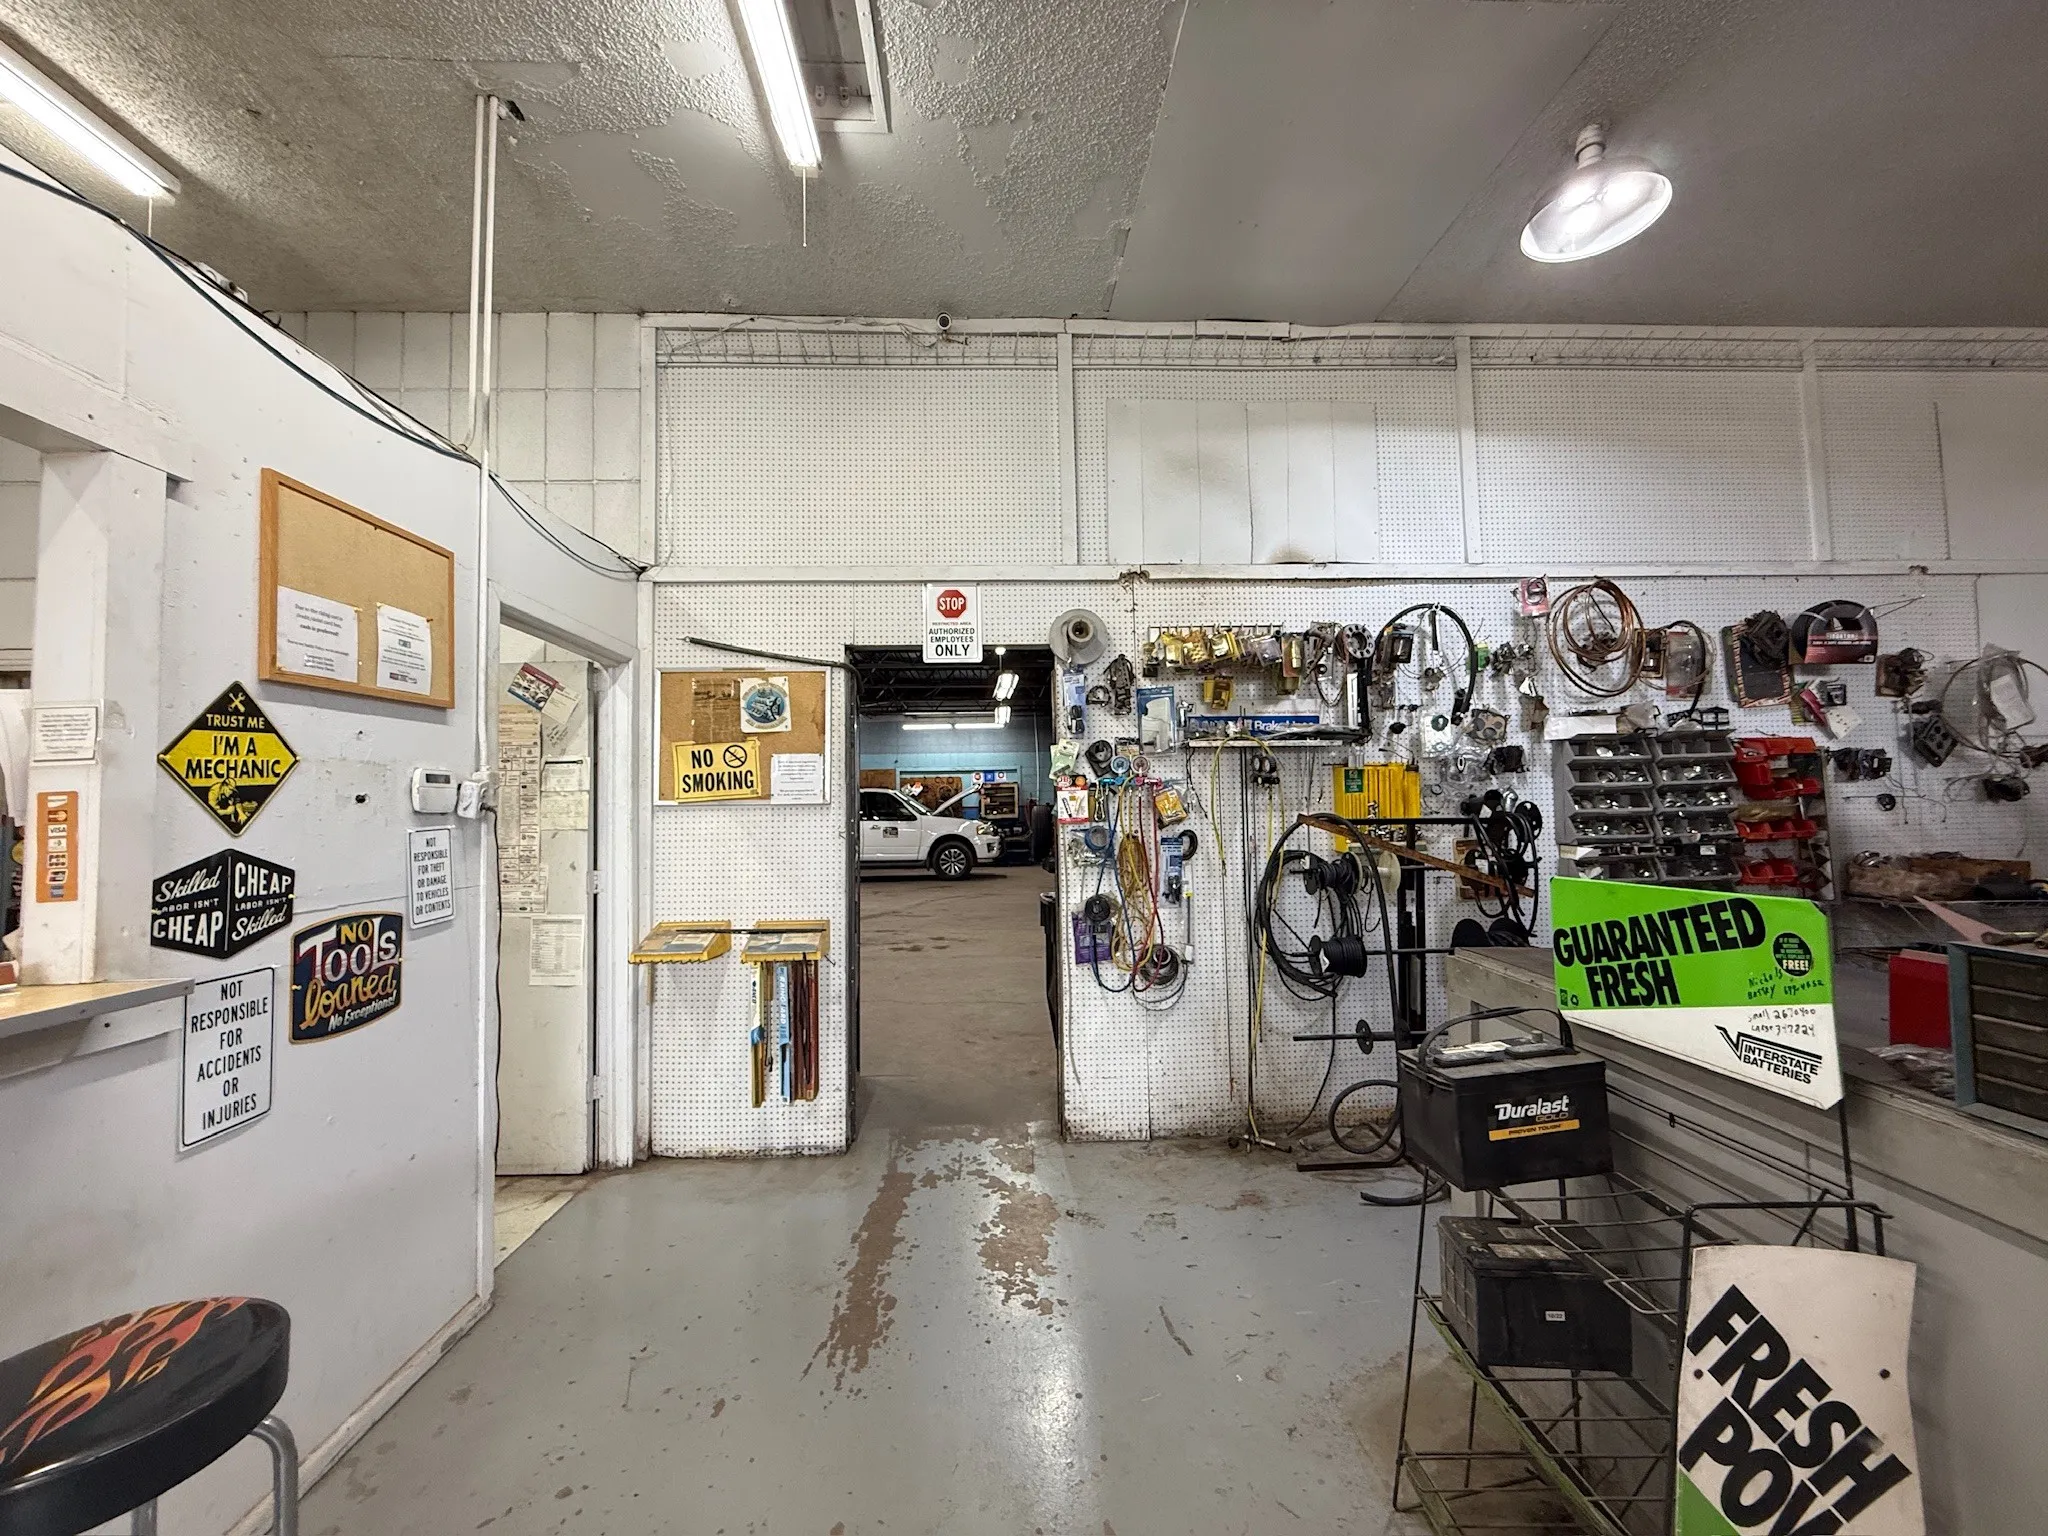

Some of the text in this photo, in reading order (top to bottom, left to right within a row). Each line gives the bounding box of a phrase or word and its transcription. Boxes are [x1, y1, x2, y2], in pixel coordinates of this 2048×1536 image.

[939, 597, 964, 610] STOP
[936, 644, 970, 656] ONLY
[206, 714, 265, 729] TRUST ME
[213, 736, 257, 756] I'M A
[185, 758, 281, 779] MECHANIC
[691, 748, 714, 768] NO
[682, 770, 754, 793] SMOKING
[426, 837, 436, 848] NOT
[414, 849, 448, 862] RESPONSIBLE
[418, 862, 444, 875] FOR THEFT
[155, 865, 222, 902] Skilled
[234, 862, 292, 898] CHEAP
[417, 875, 446, 888] OR DAMAGE
[235, 897, 287, 912] LABOR ISN'T
[416, 888, 448, 902] TO VEHICLES
[157, 898, 220, 914] ABOR ISN'T
[416, 900, 450, 916] OR CONTENTS
[153, 911, 224, 948] CHEAP
[232, 904, 288, 941] Skilled
[340, 920, 374, 944] NO
[1554, 897, 1766, 968] GUARANTEED
[1782, 960, 1809, 971] FREE!
[220, 980, 243, 1000] NOT
[1585, 958, 1681, 1008] FRESH
[299, 966, 397, 1030] loaned
[191, 996, 268, 1034] RESPONSIBLE
[328, 990, 397, 1031] No Exceptions!
[220, 1028, 242, 1050] FOR
[196, 1045, 262, 1082] ACCIDENTS
[1743, 1054, 1812, 1084] BATTERIES
[1745, 1044, 1819, 1076] INTERSTATE
[222, 1077, 238, 1096] OR
[202, 1093, 257, 1130] INJURIES
[1494, 1095, 1569, 1120] Duralast
[1536, 1112, 1569, 1122] GOLD
[1509, 1127, 1536, 1135] PROVEN
[1686, 1284, 1912, 1524] FRESH
